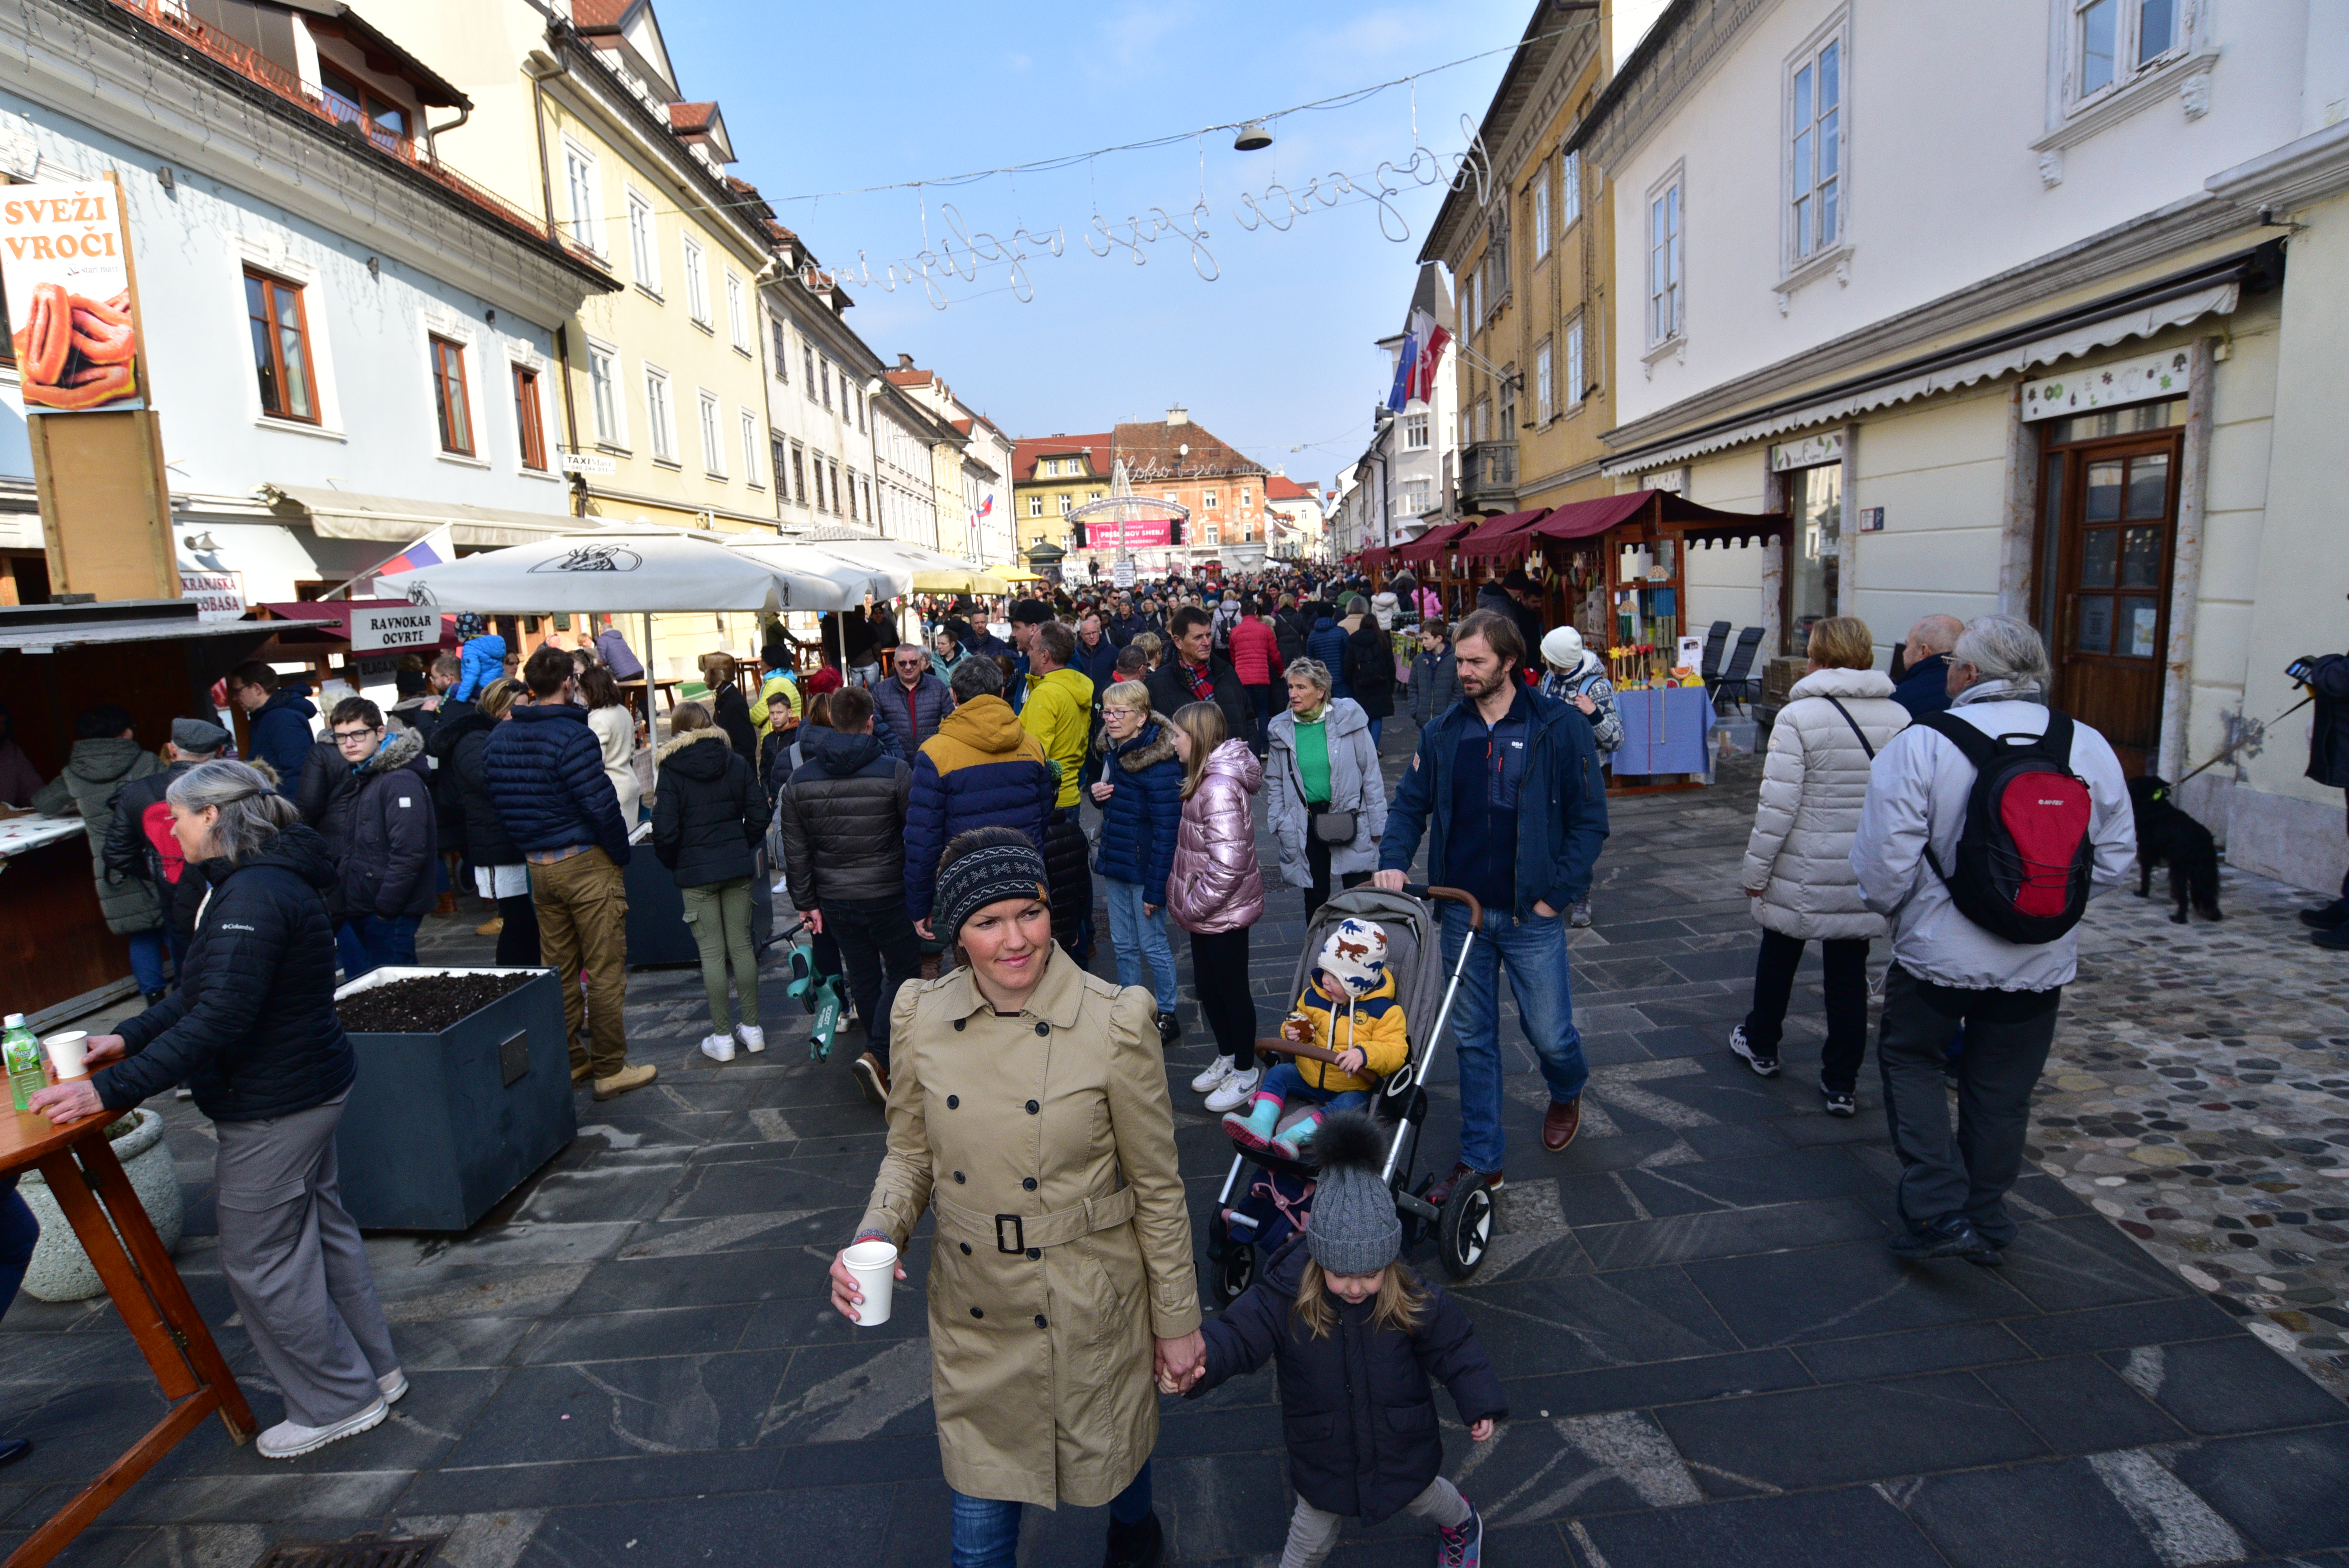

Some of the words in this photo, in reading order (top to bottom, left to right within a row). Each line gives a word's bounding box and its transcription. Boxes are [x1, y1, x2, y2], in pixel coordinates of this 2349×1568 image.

[5, 191, 108, 225] SVEŽI
[5, 226, 117, 261] VROČI
[567, 456, 590, 465] TAXI
[181, 577, 237, 591] KRANJSKA
[195, 596, 240, 612] OBASA
[371, 615, 431, 631] RAVNOKAR
[383, 630, 424, 645] OCVRTE
[361, 660, 398, 675] BLAGAJN
[823, 1005, 832, 1026] SCOOT
